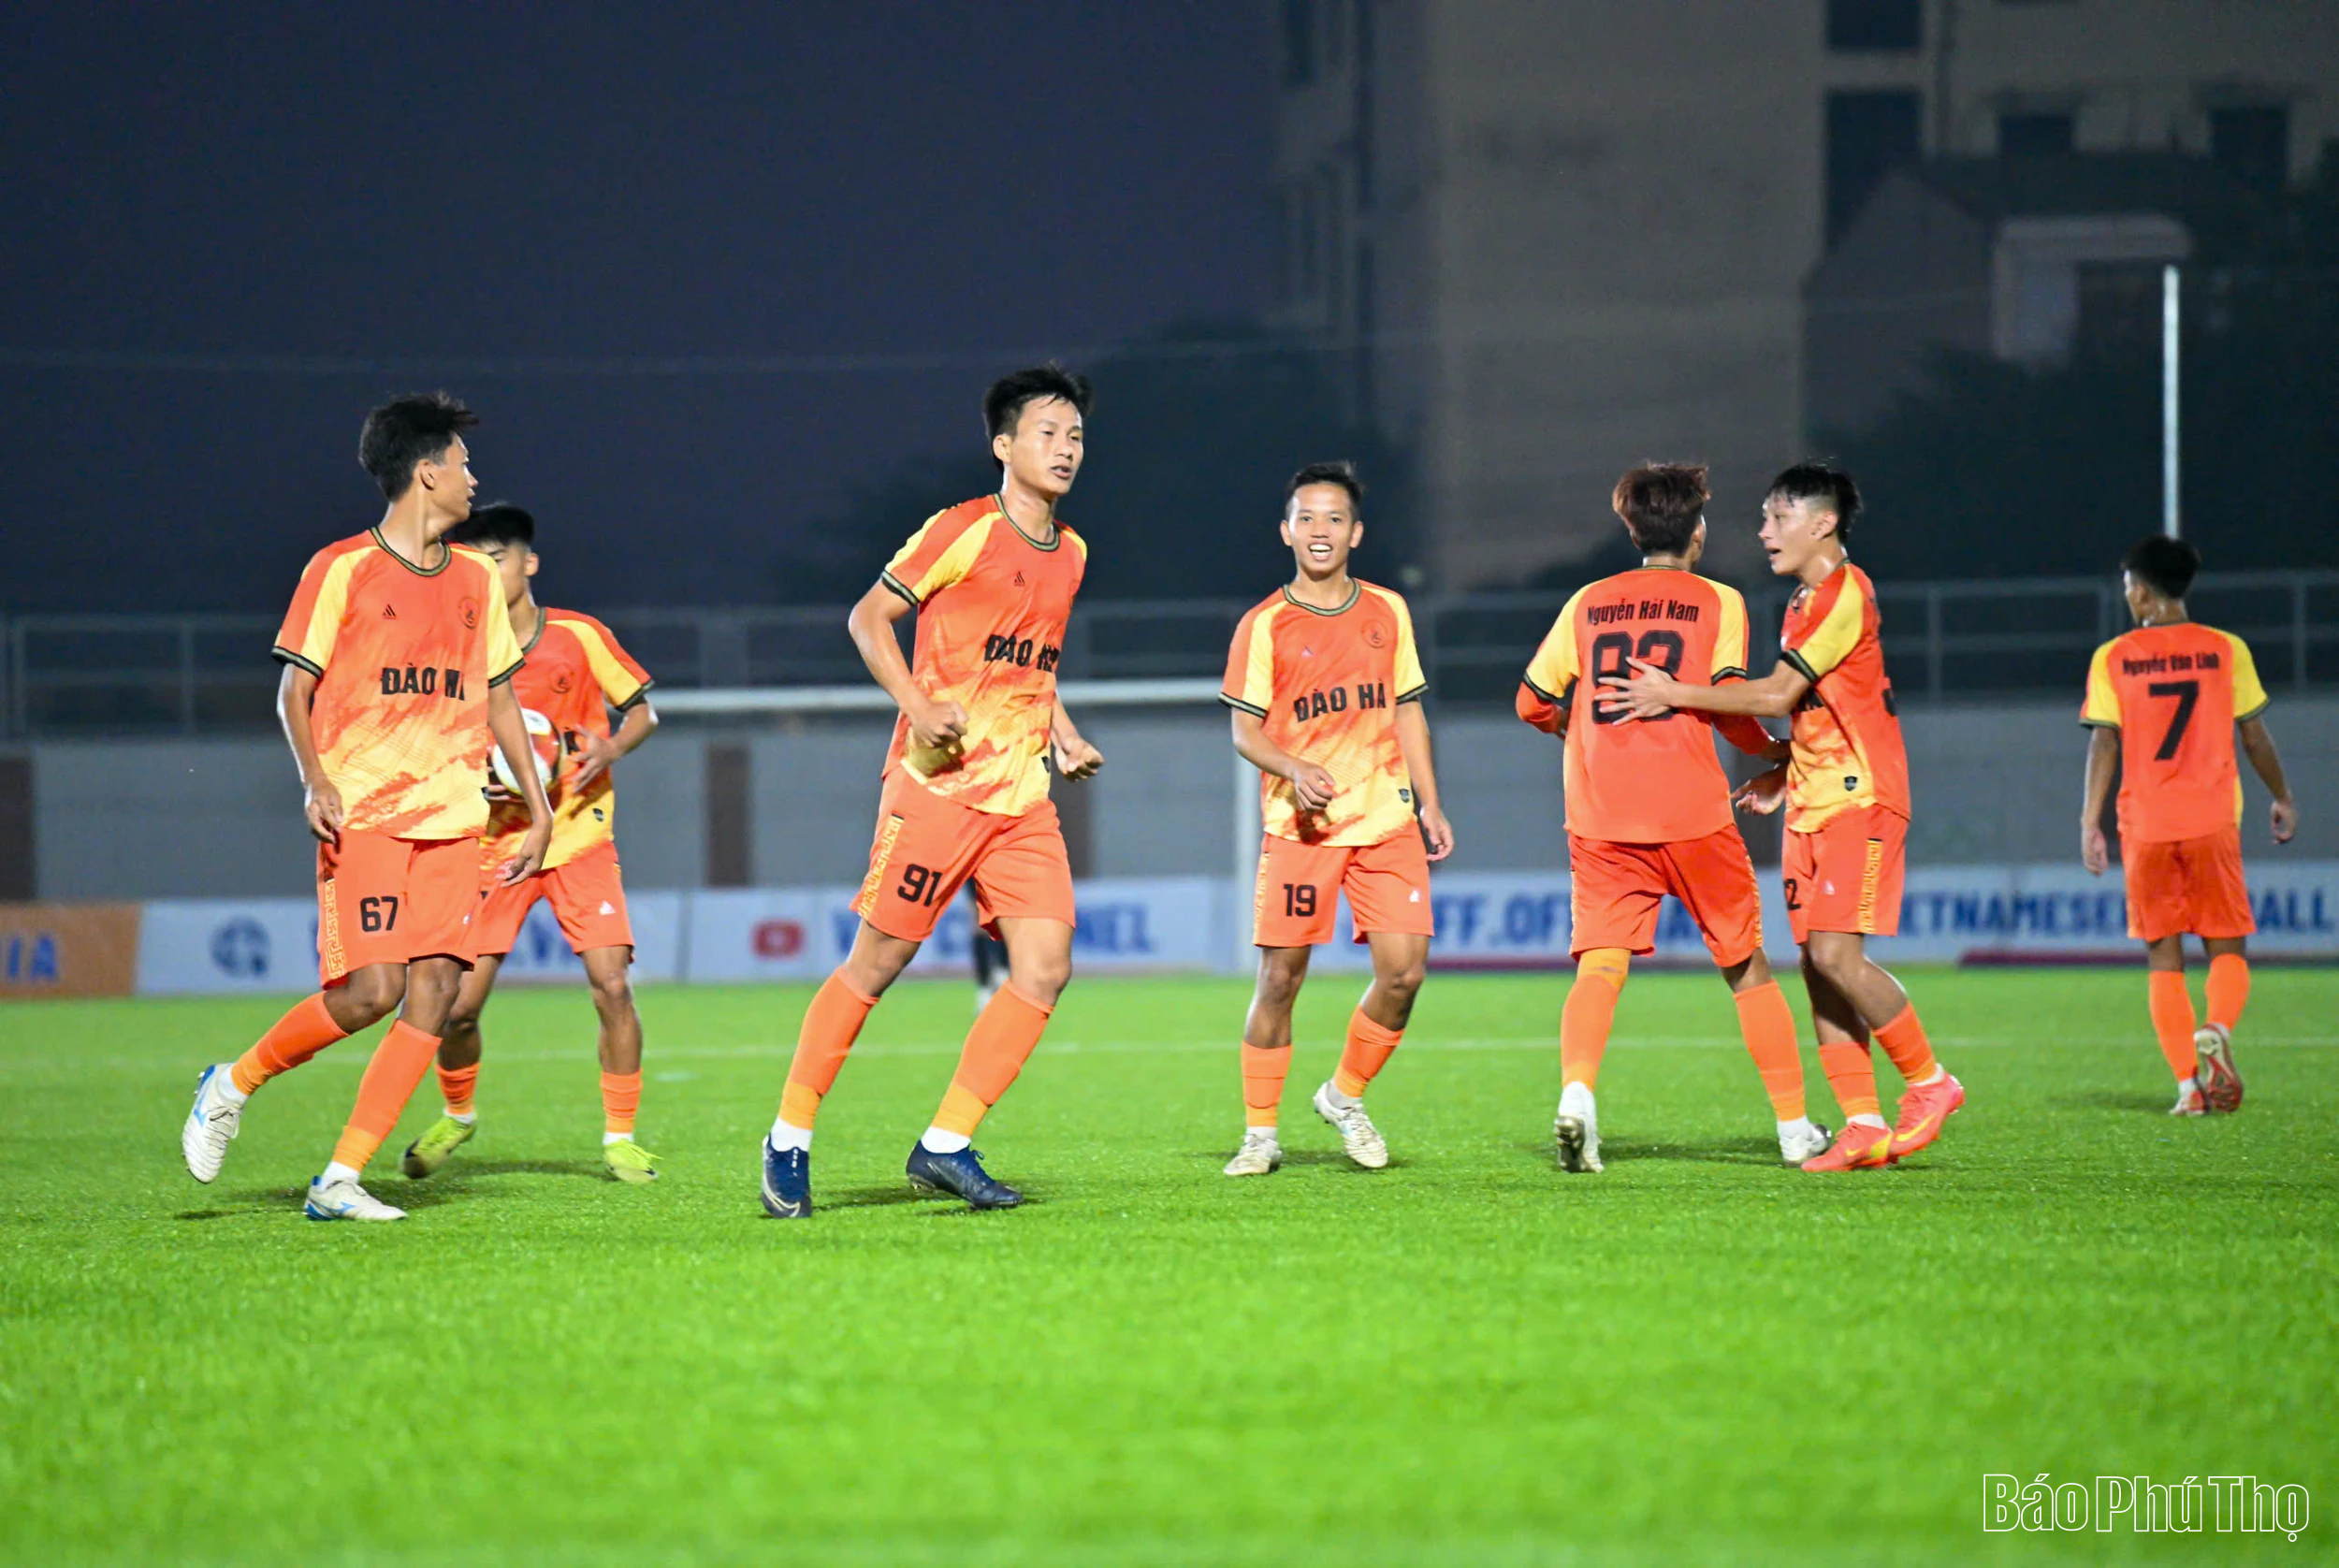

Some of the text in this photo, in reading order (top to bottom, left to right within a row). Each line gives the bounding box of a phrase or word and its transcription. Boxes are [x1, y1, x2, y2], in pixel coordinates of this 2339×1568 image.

[1665, 599, 1700, 623] Nam
[380, 662, 438, 695] ĐÀO
[1293, 688, 1347, 723] ĐÀO
[2148, 680, 2200, 761] 7
[897, 864, 943, 907] 91
[1284, 883, 1317, 918] 19
[360, 895, 399, 933] 67
